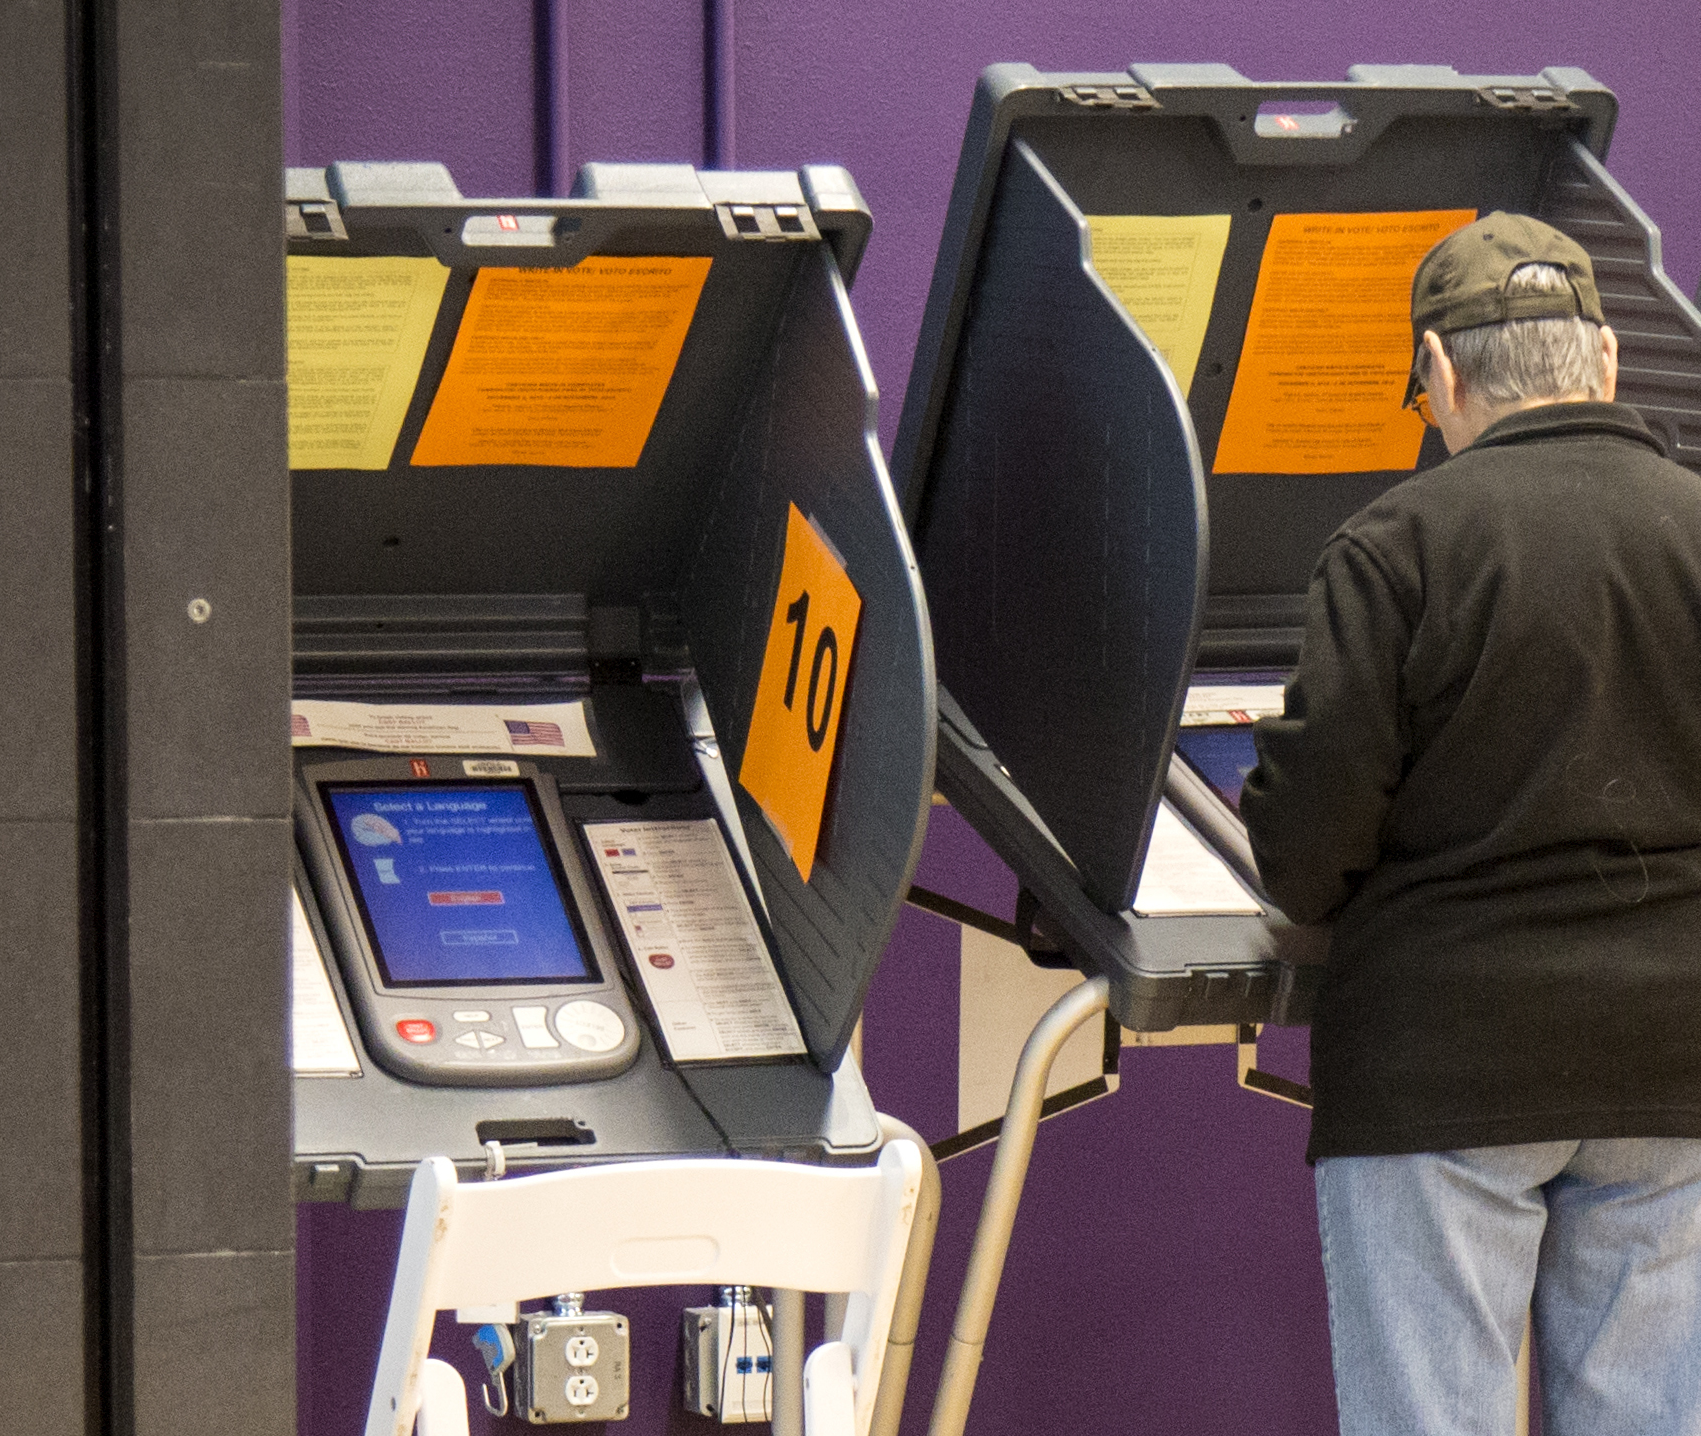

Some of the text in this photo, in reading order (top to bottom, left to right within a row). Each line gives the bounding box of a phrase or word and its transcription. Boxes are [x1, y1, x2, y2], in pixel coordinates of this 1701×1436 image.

[783, 588, 838, 753] 10
[373, 801, 487, 813] Select a Language
